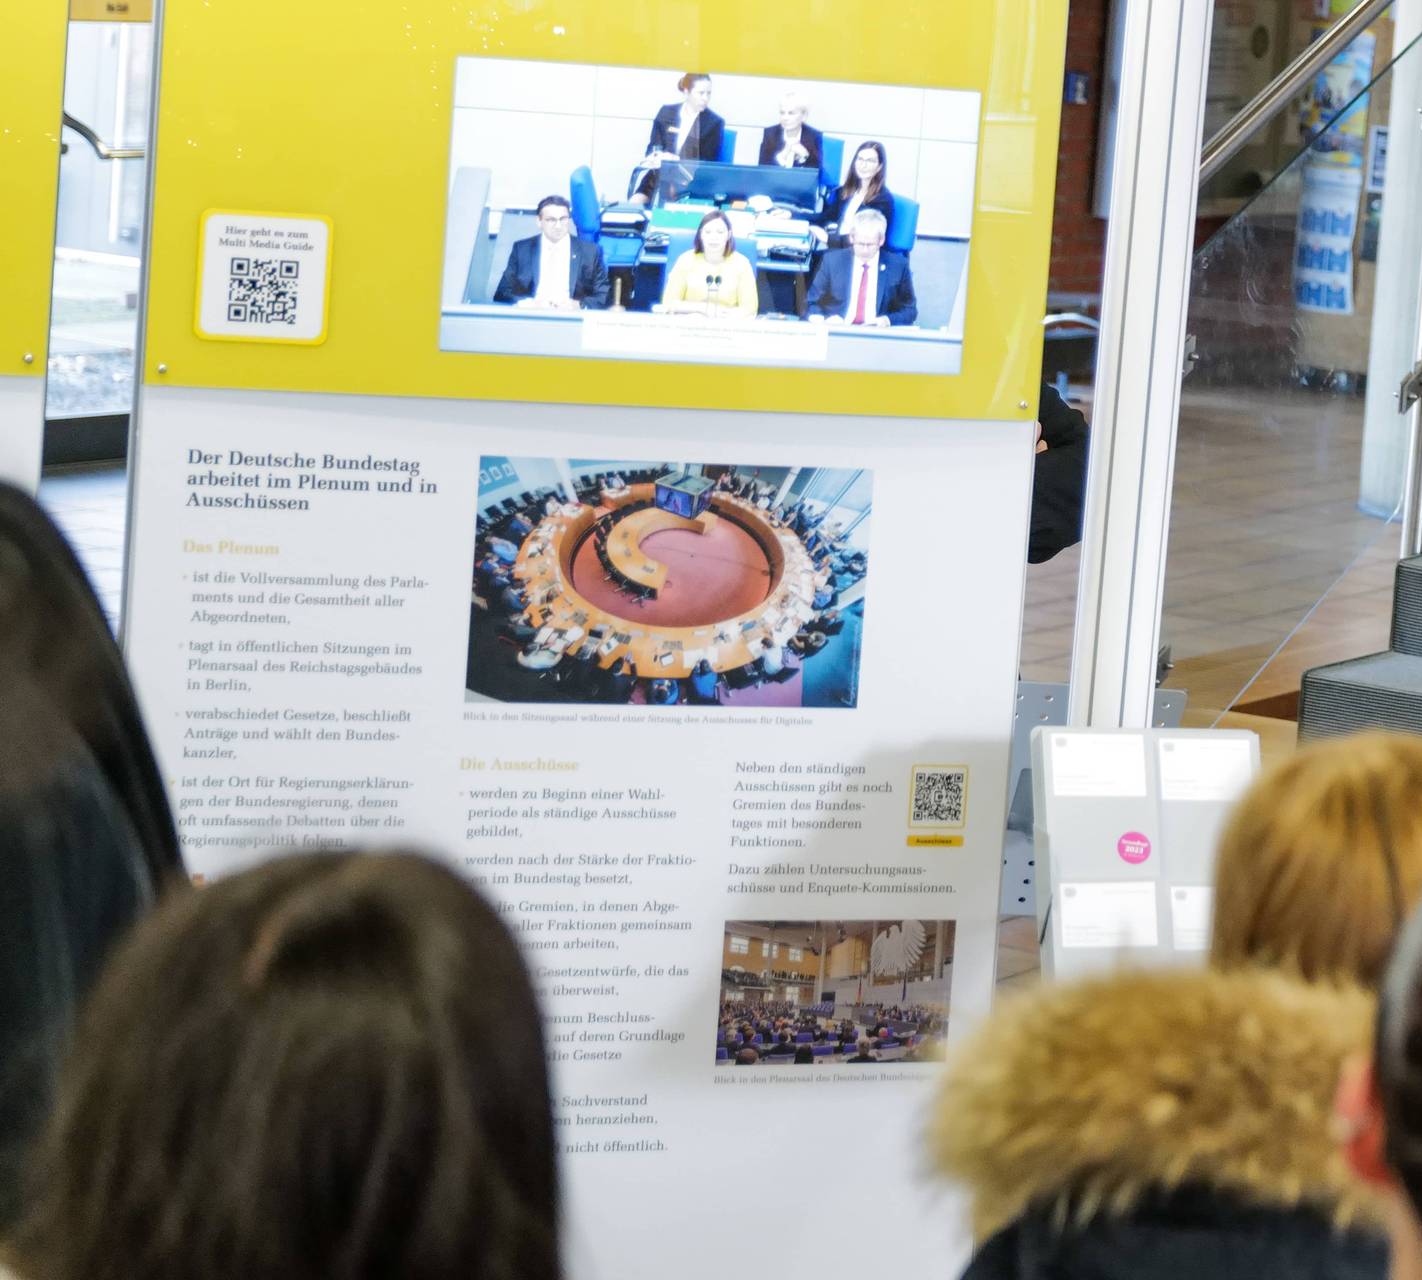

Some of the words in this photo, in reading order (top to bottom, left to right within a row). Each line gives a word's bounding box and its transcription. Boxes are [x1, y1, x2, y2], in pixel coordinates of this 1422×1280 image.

[225, 226, 247, 234] Hier
[250, 228, 271, 237] geht
[219, 238, 245, 247] Multi
[249, 240, 280, 249] Media
[284, 242, 314, 251] Guide
[188, 449, 222, 465] Der
[228, 450, 316, 468] Deutsche
[322, 454, 420, 476] Bundestag
[187, 471, 260, 487] arbeitet
[267, 473, 291, 488] im
[298, 474, 369, 491] Plenum
[377, 478, 412, 493] und
[420, 479, 438, 493] in
[186, 492, 310, 510] Ausschüssen
[183, 540, 212, 553] Das
[218, 540, 280, 554] Plenum
[193, 572, 209, 583] ist
[214, 572, 235, 583] die
[240, 572, 359, 589] Vollversammlung
[363, 575, 386, 587] des
[391, 576, 428, 588] Parla-
[192, 593, 234, 603] ments
[238, 592, 264, 604] und
[269, 593, 290, 604] die
[294, 594, 370, 606] Gesamtheit
[374, 595, 405, 607] aller
[191, 611, 290, 625] Abgeordneten,
[189, 641, 213, 653] tagt
[219, 641, 231, 651] in
[236, 641, 318, 654] öffentlichen
[323, 642, 390, 657] Sitzungen
[395, 644, 412, 656] im
[188, 659, 258, 672] Plenarsaal
[263, 661, 285, 672] des
[289, 662, 422, 676] Reichstagsgebäudes
[187, 679, 200, 690] in
[205, 679, 251, 692] Berlin,
[185, 708, 279, 720] verabschiedet
[283, 710, 339, 722] Gesetze,
[344, 710, 411, 722] beschließt
[184, 728, 238, 741] Anträge
[242, 729, 269, 740] und
[274, 729, 311, 740] wählt
[316, 729, 340, 740] den
[346, 730, 400, 741] Bundes-
[183, 747, 237, 760] kanzler,
[460, 758, 485, 770] Die
[491, 758, 579, 771] Ausschüsse
[736, 762, 775, 773] Neben
[780, 762, 802, 773] den
[806, 763, 865, 776] ständigen
[182, 777, 197, 787] ist
[202, 777, 224, 787] der
[228, 777, 250, 788] Ort
[256, 777, 274, 788] für
[279, 777, 414, 790] Regierungserklärun-
[734, 781, 815, 792] Ausschüssen
[819, 781, 842, 794] gibt
[847, 783, 858, 792] es
[863, 782, 892, 793] noch
[470, 788, 517, 800] werden
[522, 789, 537, 800] zu
[542, 788, 586, 802] Beginn
[591, 789, 623, 800] einer
[629, 789, 664, 800] Wahl-
[180, 797, 204, 809] gen
[208, 796, 230, 807] der
[235, 796, 352, 810] Bundesregierung,
[358, 796, 398, 808] denen
[732, 799, 787, 811] Gremien
[790, 799, 811, 811] des
[815, 800, 865, 811] Bundes-
[468, 807, 517, 821] periode
[522, 807, 540, 819] als
[544, 807, 598, 821] ständige
[602, 808, 676, 819] Ausschüsse
[179, 815, 197, 827] oft
[202, 815, 281, 827] umfassende
[287, 815, 345, 827] Debatten
[350, 816, 379, 827] über
[384, 816, 405, 827] die
[732, 819, 762, 830] tages
[767, 818, 787, 828] mit
[791, 818, 862, 829] besonderen
[466, 826, 522, 839] gebildet,
[179, 835, 297, 848] Regierungspolitik
[731, 836, 806, 848] Funktionen.
[465, 854, 513, 865] werden
[518, 854, 548, 865] nach
[553, 854, 574, 865] der
[578, 854, 618, 865] Stärke
[622, 854, 643, 865] der
[647, 854, 696, 865] Fraktio-
[729, 864, 760, 875] Dazu
[764, 864, 805, 875] zählen
[810, 864, 926, 878] Untersuchungsaus-
[493, 873, 509, 884] im
[514, 873, 581, 886] Bundestag
[585, 873, 632, 884] besetzt,
[727, 883, 775, 894] schüsse
[780, 883, 803, 894] und
[808, 883, 956, 896] Enquete-Kommissionen.
[519, 901, 577, 913] Gremien,
[583, 901, 594, 911] in
[600, 901, 638, 912] denen
[643, 901, 679, 914] Abge-
[548, 920, 616, 930] Fraktionen
[621, 920, 692, 932] gemeinsam
[563, 939, 619, 950] arbeiten,
[536, 966, 640, 978] Gesetzentwürfe,
[645, 966, 664, 977] die
[668, 966, 689, 976] das
[552, 985, 619, 996] überweist,
[588, 1012, 655, 1023] Beschluss-
[554, 1031, 576, 1042] auf
[579, 1031, 615, 1041] deren
[619, 1030, 685, 1043] Grundlage
[573, 1050, 622, 1061] Gesetze
[562, 1095, 647, 1107] Sachverstand
[576, 1114, 658, 1125] heranziehen,
[566, 1142, 599, 1153] nicht
[604, 1141, 668, 1152] öffentlich.
